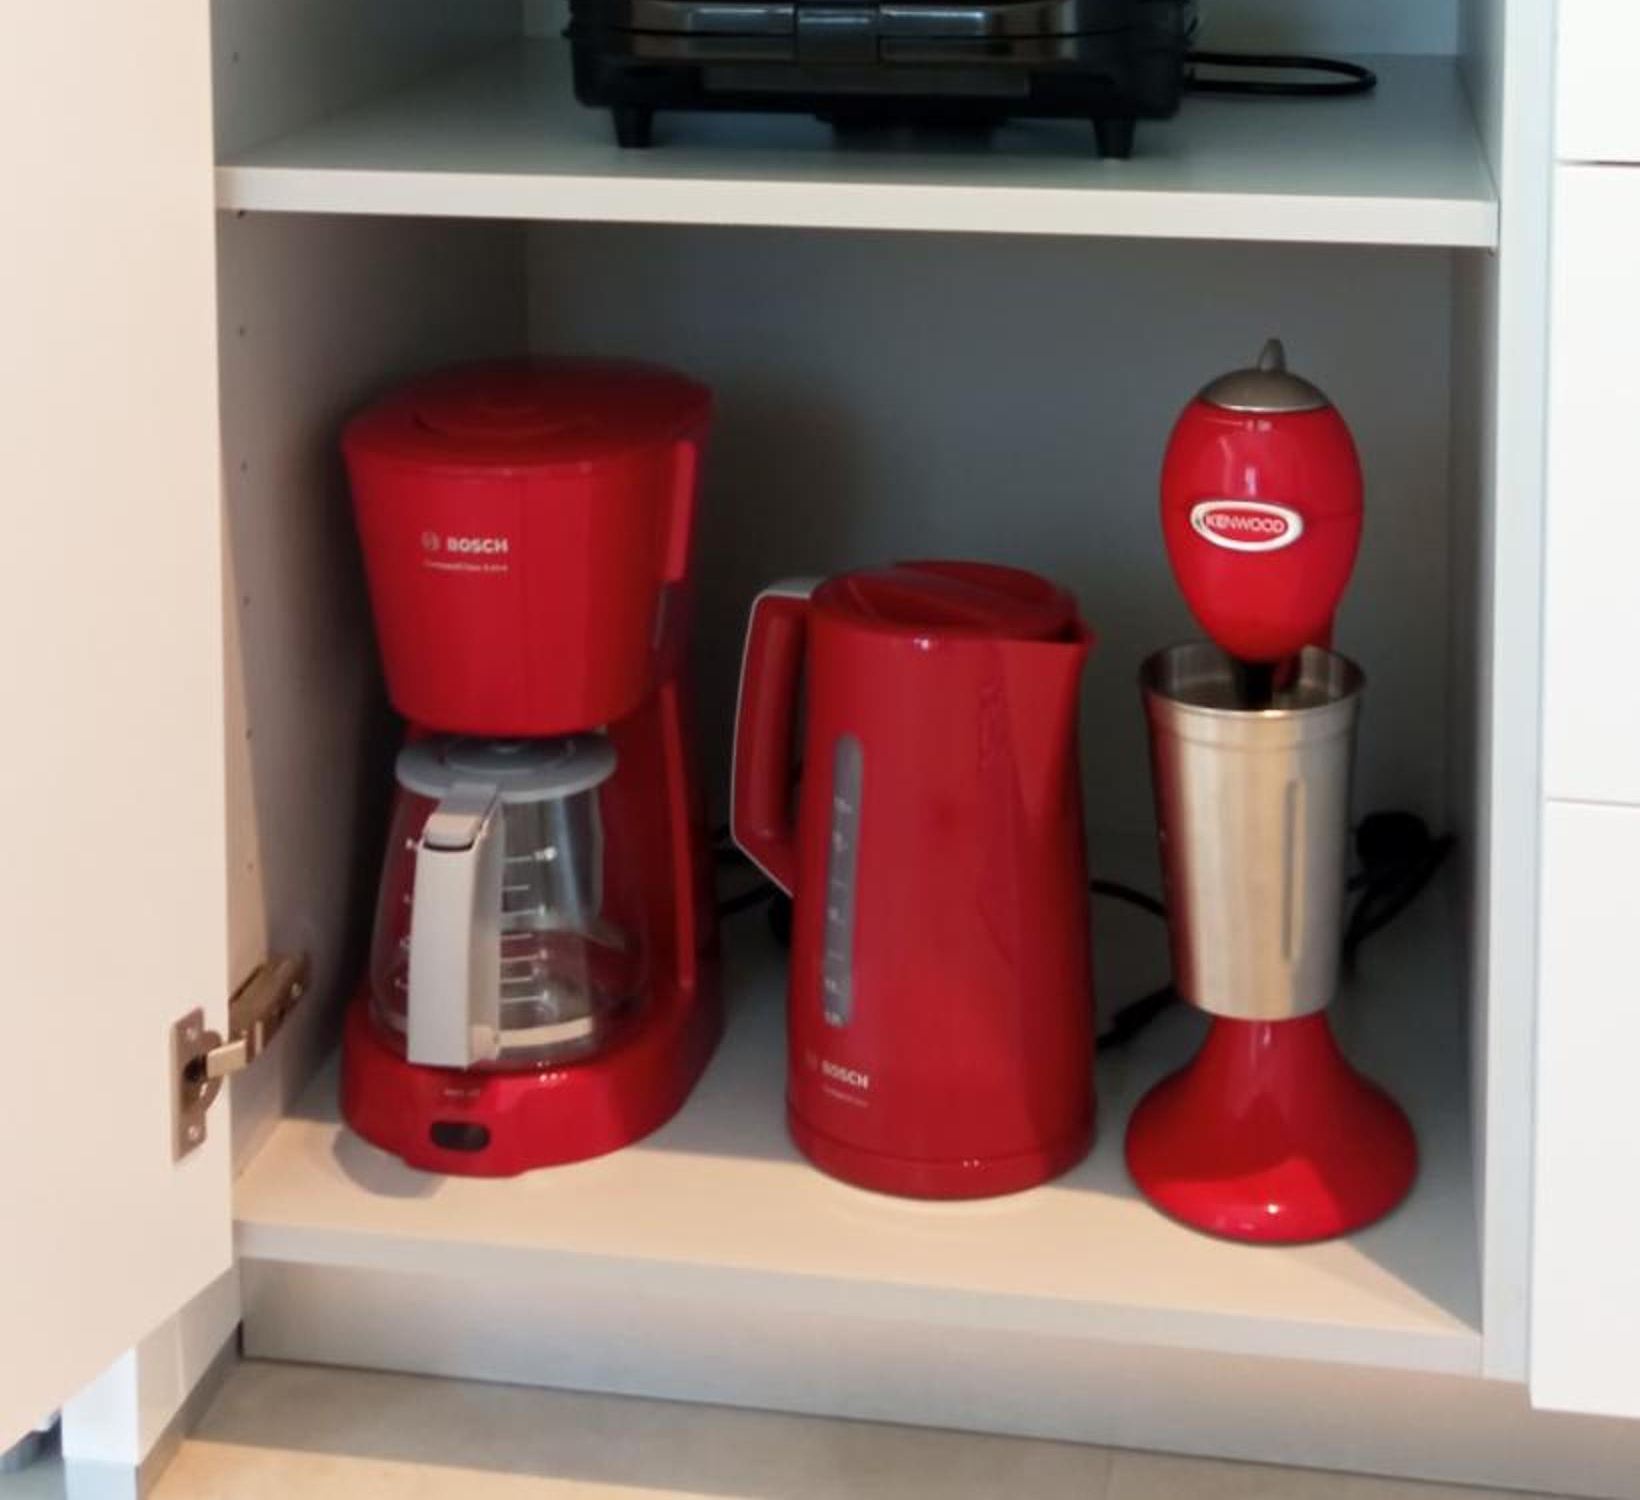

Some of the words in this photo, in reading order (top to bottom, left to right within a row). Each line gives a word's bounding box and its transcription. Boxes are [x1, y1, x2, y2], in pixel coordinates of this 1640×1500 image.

[1205, 513, 1284, 533] KENWOOD
[447, 537, 509, 554] BOSCH
[821, 1059, 870, 1090] BOSCH
